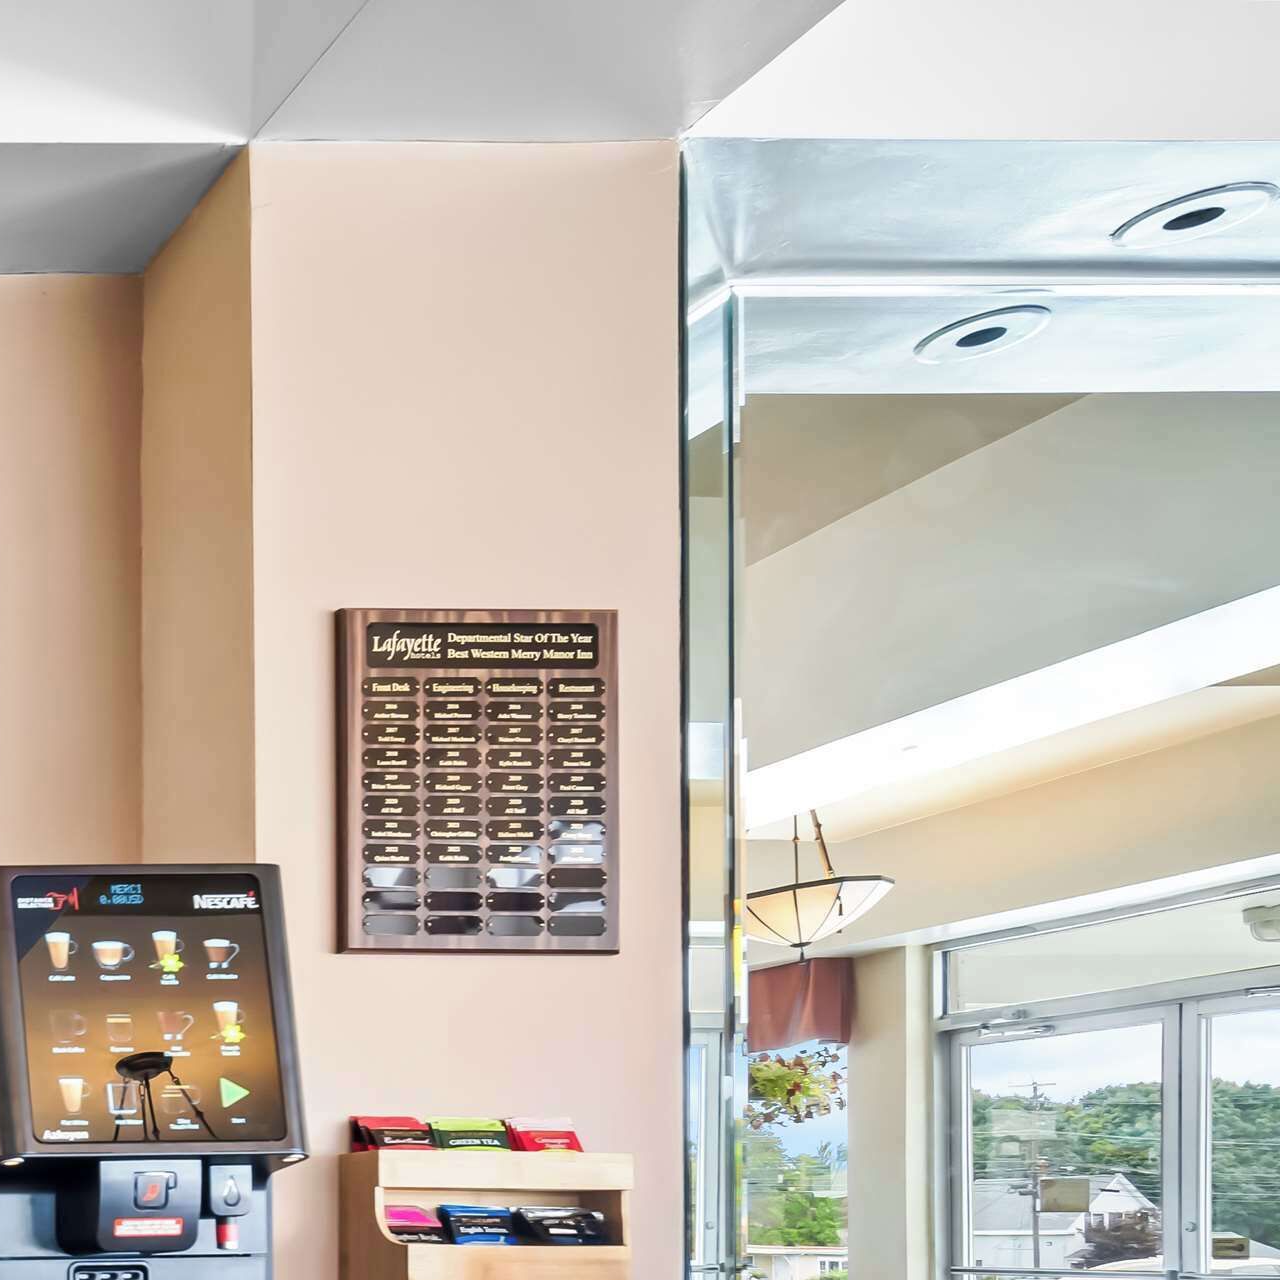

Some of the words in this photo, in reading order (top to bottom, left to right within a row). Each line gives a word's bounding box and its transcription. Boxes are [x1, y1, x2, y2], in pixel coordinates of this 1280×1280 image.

[372, 630, 441, 660] Lafayette
[447, 632, 511, 645] Departmental
[513, 633, 533, 643] Star
[535, 633, 551, 643] Of
[551, 633, 569, 643] The
[570, 633, 593, 643] Year
[447, 648, 469, 659] Best
[470, 649, 509, 659] Western
[511, 649, 541, 661] Merry
[543, 649, 575, 659] Manor
[576, 649, 593, 659] Inn
[110, 884, 141, 893] MERCI
[449, 1138, 481, 1146] GREEN
[482, 1138, 500, 1146] TEA
